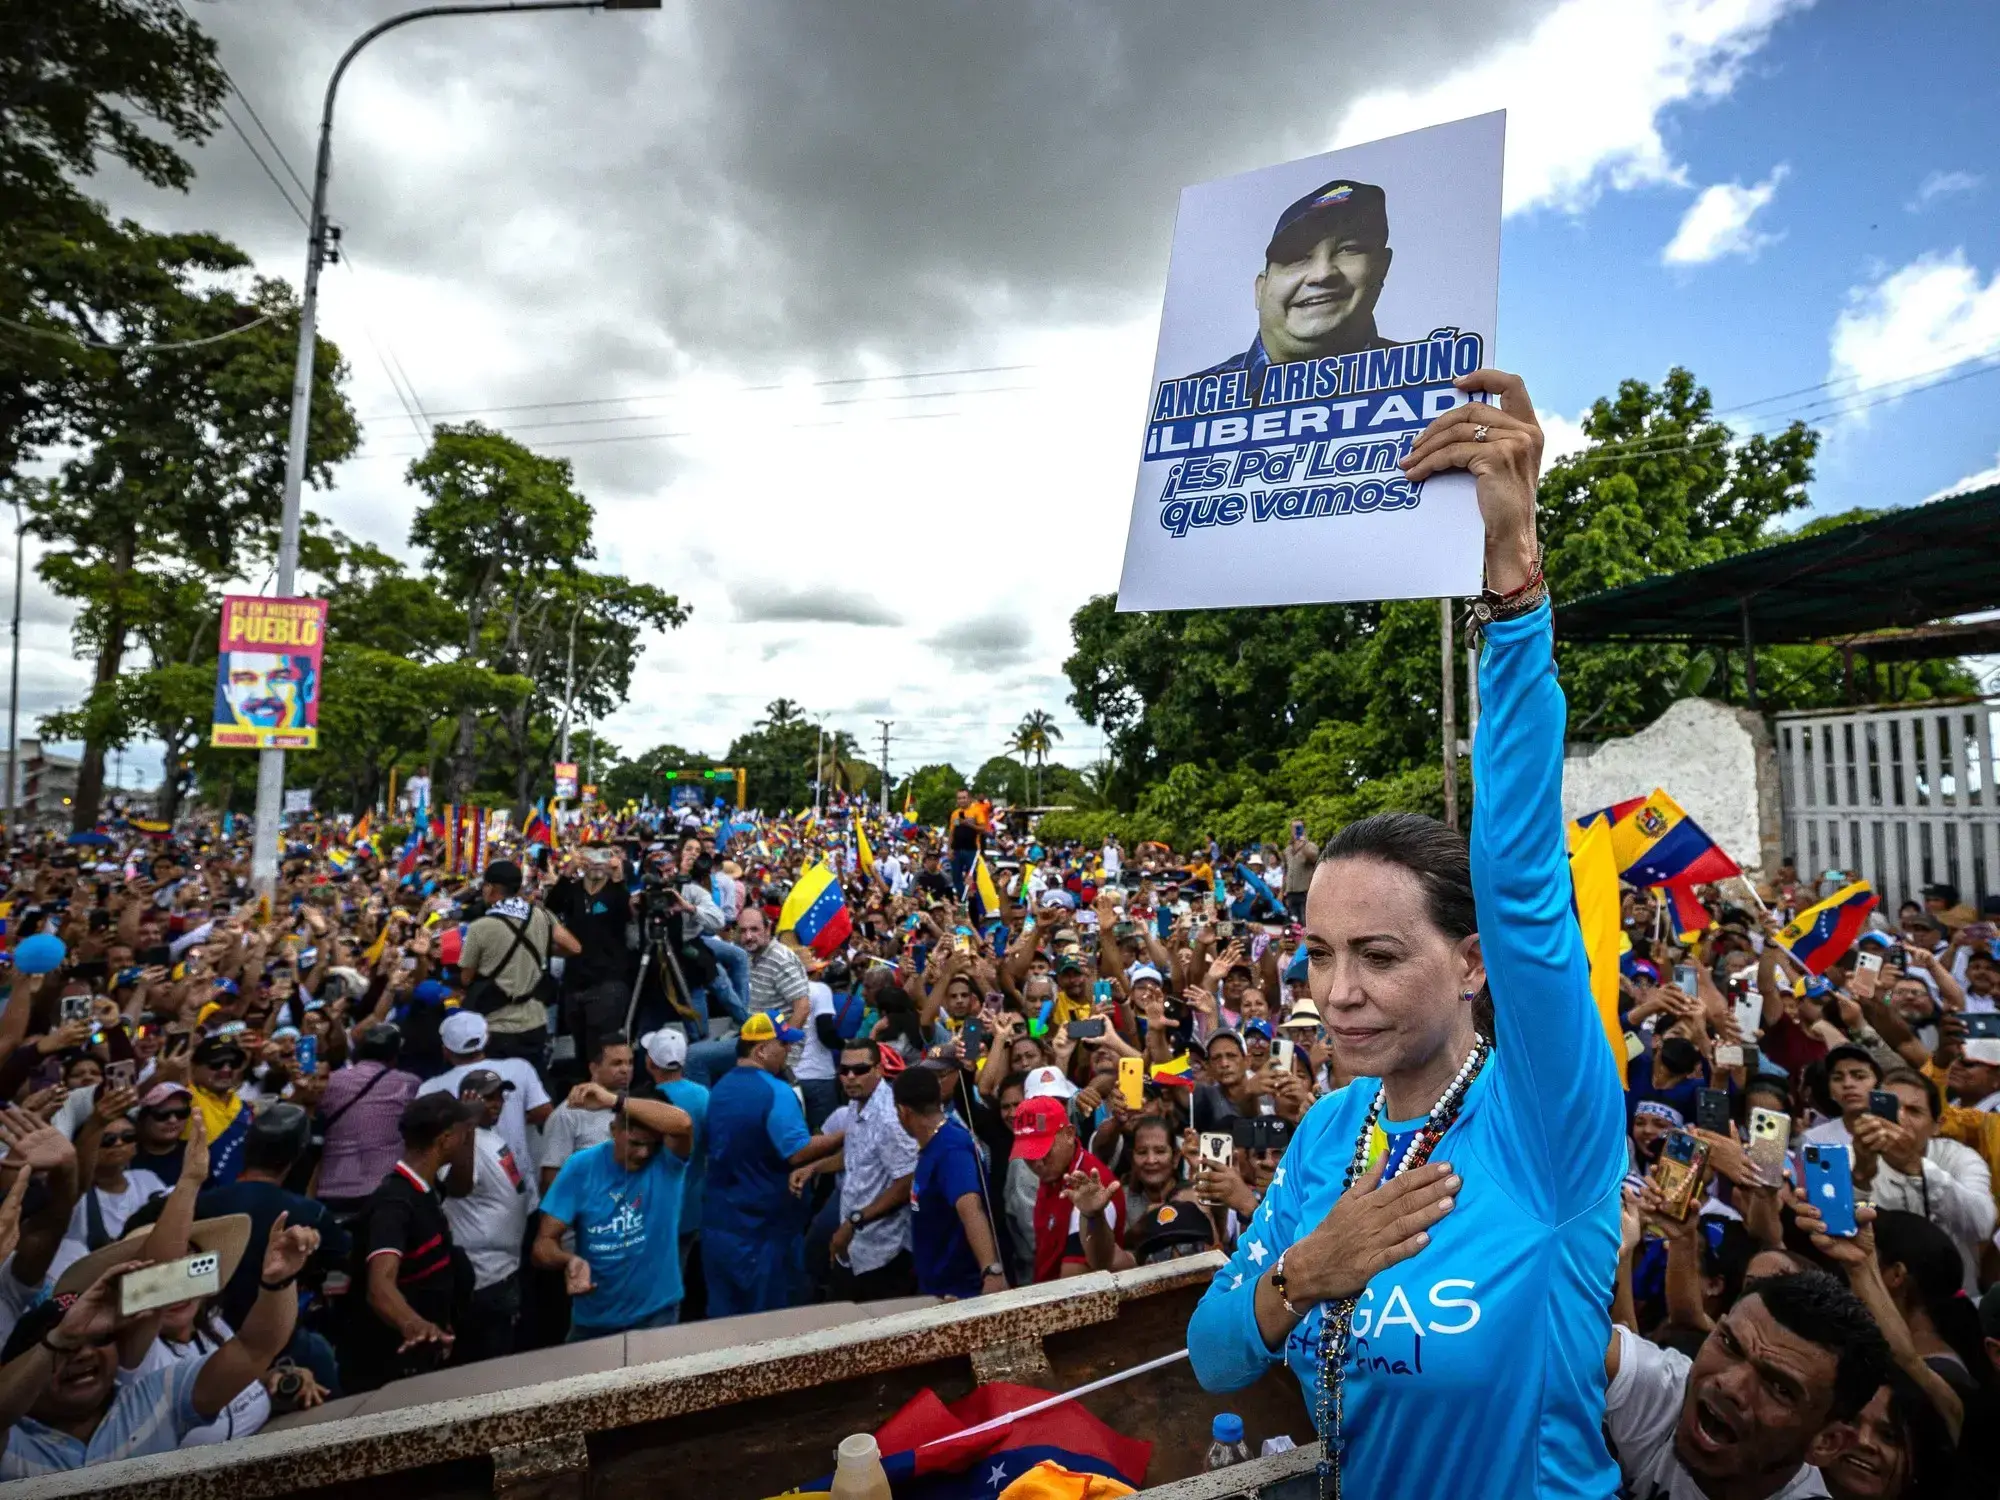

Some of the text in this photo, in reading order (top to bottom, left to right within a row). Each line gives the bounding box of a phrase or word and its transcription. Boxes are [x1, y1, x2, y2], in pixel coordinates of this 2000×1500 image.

[1153, 329, 1481, 422] ANGEL ARISTIMUÑO
[1147, 387, 1487, 455] ¡LIBERTAD
[1161, 430, 1416, 501] ¡Es Pa' Lant
[1160, 479, 1425, 538] que vamos!
[228, 615, 318, 647] PUEBLO
